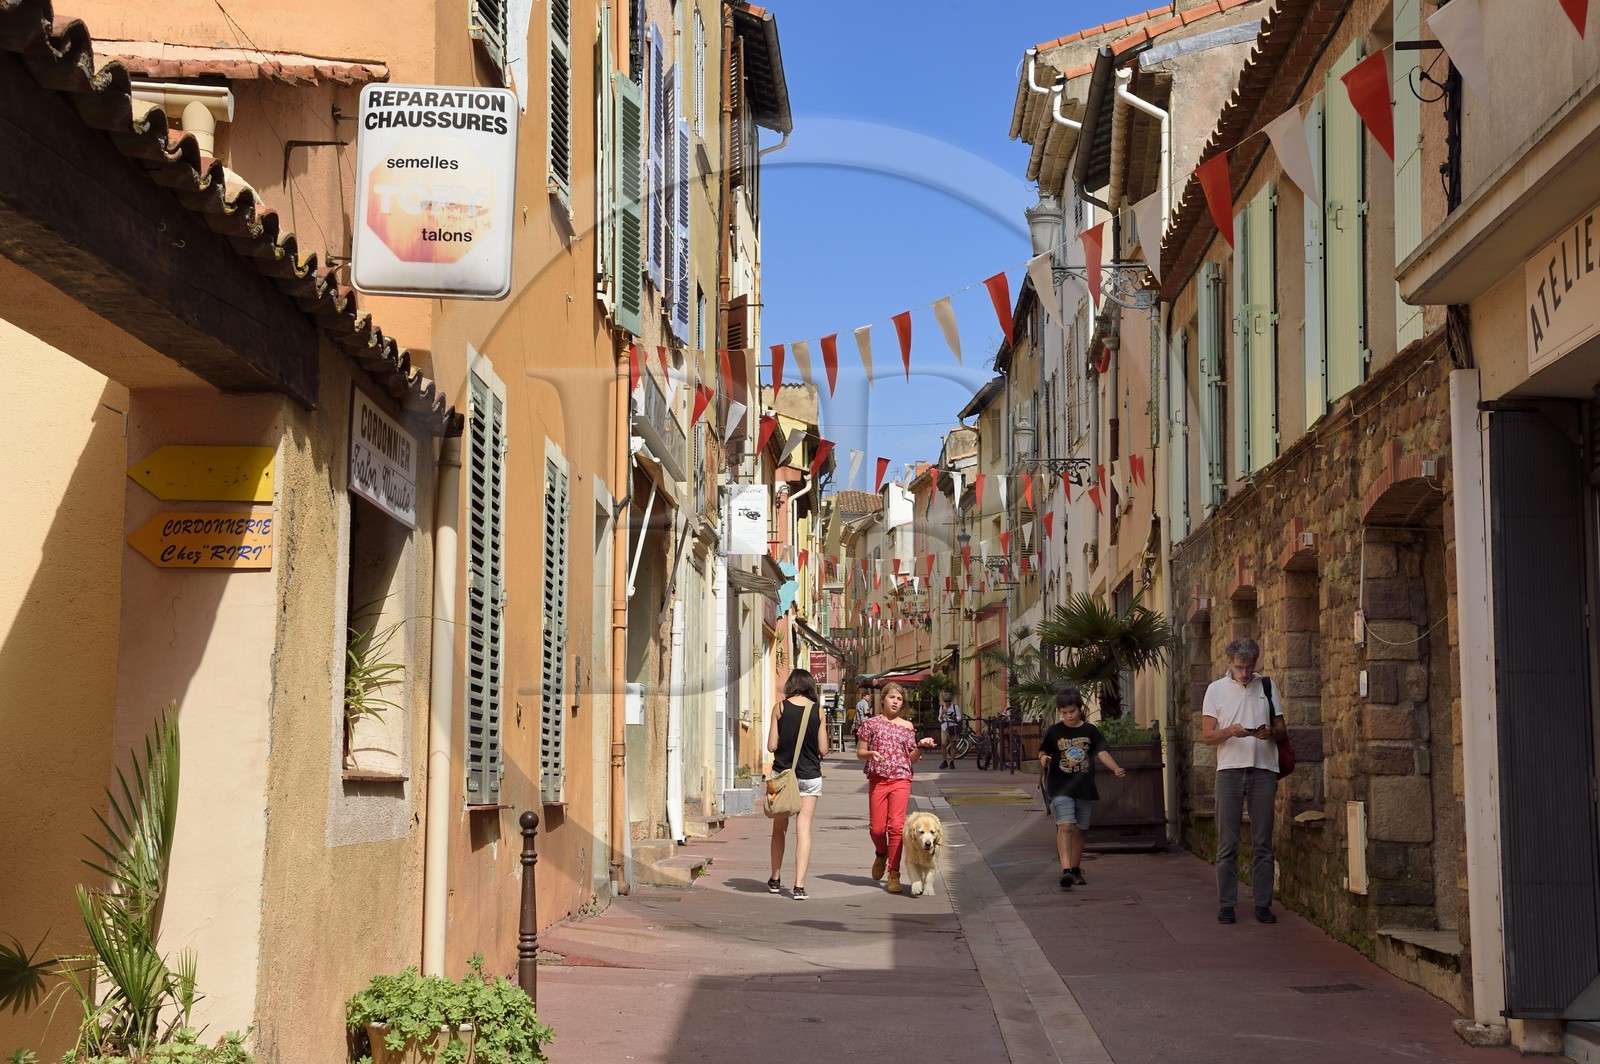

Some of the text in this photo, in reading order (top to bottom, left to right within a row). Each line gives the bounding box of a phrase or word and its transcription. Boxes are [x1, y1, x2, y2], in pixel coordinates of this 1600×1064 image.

[368, 90, 506, 113] REPARATION
[364, 110, 508, 135] CHAUSSURES
[386, 155, 459, 170] semelles
[421, 227, 473, 242] talons
[1530, 214, 1600, 355] ATELIE
[360, 403, 411, 473] CORDONNIER
[162, 518, 272, 537] CORDONNERIE
[160, 544, 202, 565] Chez
